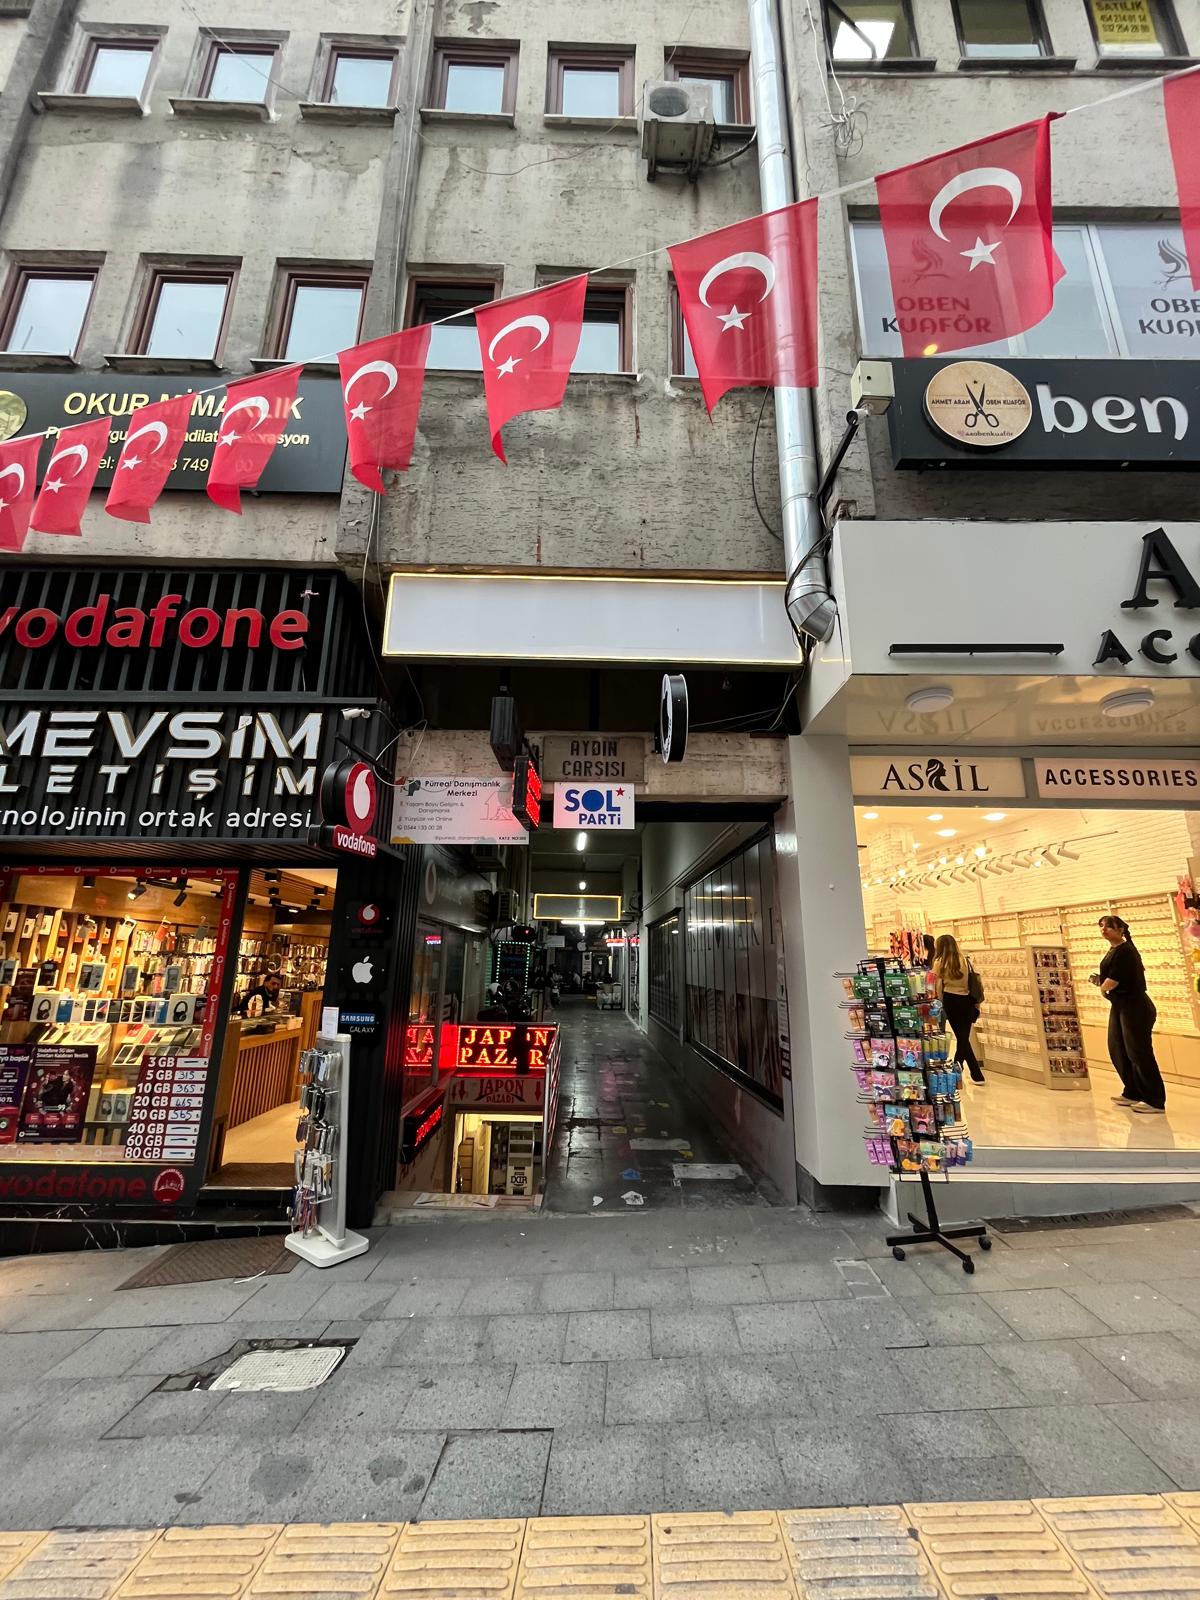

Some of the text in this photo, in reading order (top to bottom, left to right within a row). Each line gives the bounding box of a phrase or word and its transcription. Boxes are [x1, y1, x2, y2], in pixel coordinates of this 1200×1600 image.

[1095, 1, 1144, 12] SATILIK
[896, 297, 970, 312] OBEN
[1138, 319, 1200, 337] KUA
[63, 392, 150, 416] OKUR
[1036, 384, 1189, 441] ben
[182, 457, 209, 472] 749
[570, 740, 618, 757] AYDIN
[453, 779, 501, 789] Danışmanlık
[1044, 768, 1198, 787] ACCESSORIES
[564, 789, 621, 812] SOL
[138, 807, 215, 828] ortak
[225, 807, 312, 829] adresi
[336, 832, 376, 856] vodafone
[340, 1014, 375, 1023] SAMSUNG
[349, 1025, 375, 1034] GALAXY
[464, 1028, 549, 1047] JAPN
[148, 1057, 156, 1067] 3
[158, 1057, 175, 1067] GB
[145, 1070, 154, 1080] 5
[155, 1070, 173, 1080] GB
[137, 1083, 152, 1093] 10
[153, 1083, 171, 1093] GB
[479, 1079, 525, 1096] JAPON
[134, 1096, 150, 1106] 20
[151, 1096, 169, 1107] GB
[132, 1109, 147, 1120] 30
[149, 1110, 167, 1120] GB
[128, 1123, 145, 1134] 40
[147, 1123, 165, 1134] GB
[126, 1135, 143, 1146] 60
[145, 1135, 163, 1146] GB
[125, 1147, 141, 1158] 80
[143, 1148, 160, 1158] GB
